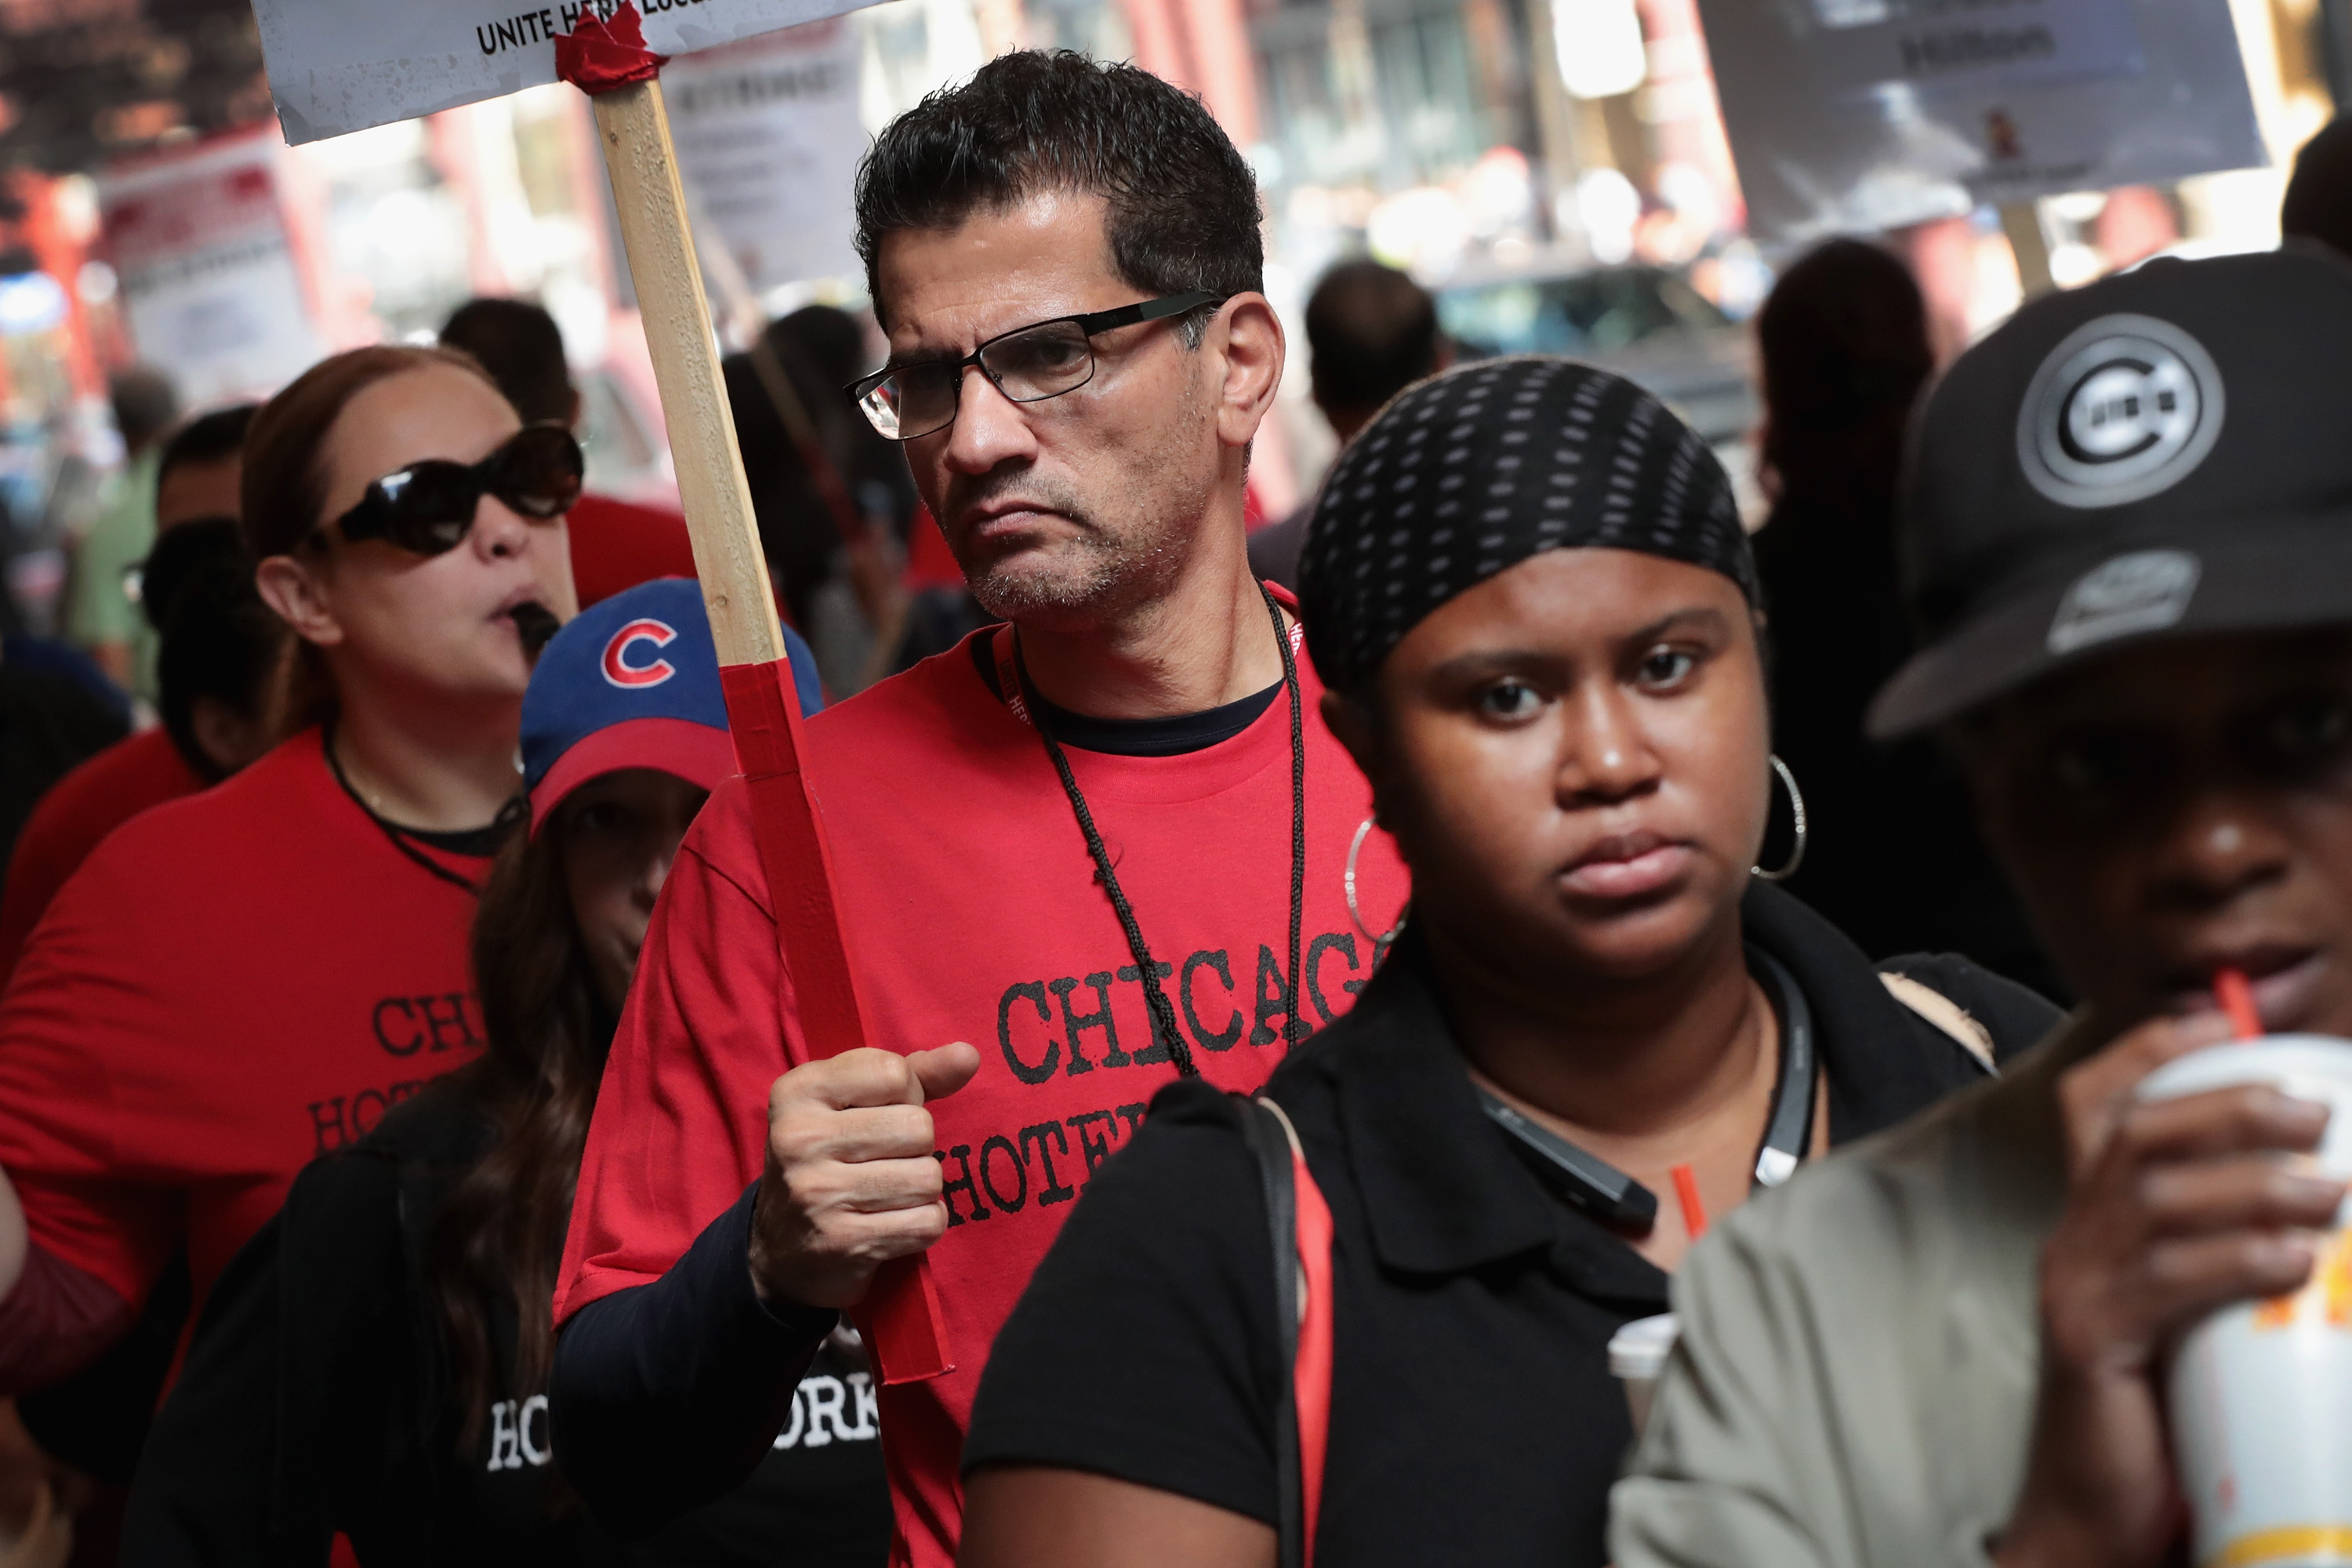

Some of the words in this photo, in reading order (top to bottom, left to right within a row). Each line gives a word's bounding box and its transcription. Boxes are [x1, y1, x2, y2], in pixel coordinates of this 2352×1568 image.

[476, 9, 557, 55] UNITE
[601, 618, 677, 689] C
[997, 931, 1391, 1085] CHICAG
[938, 1102, 1147, 1228] HOTE
